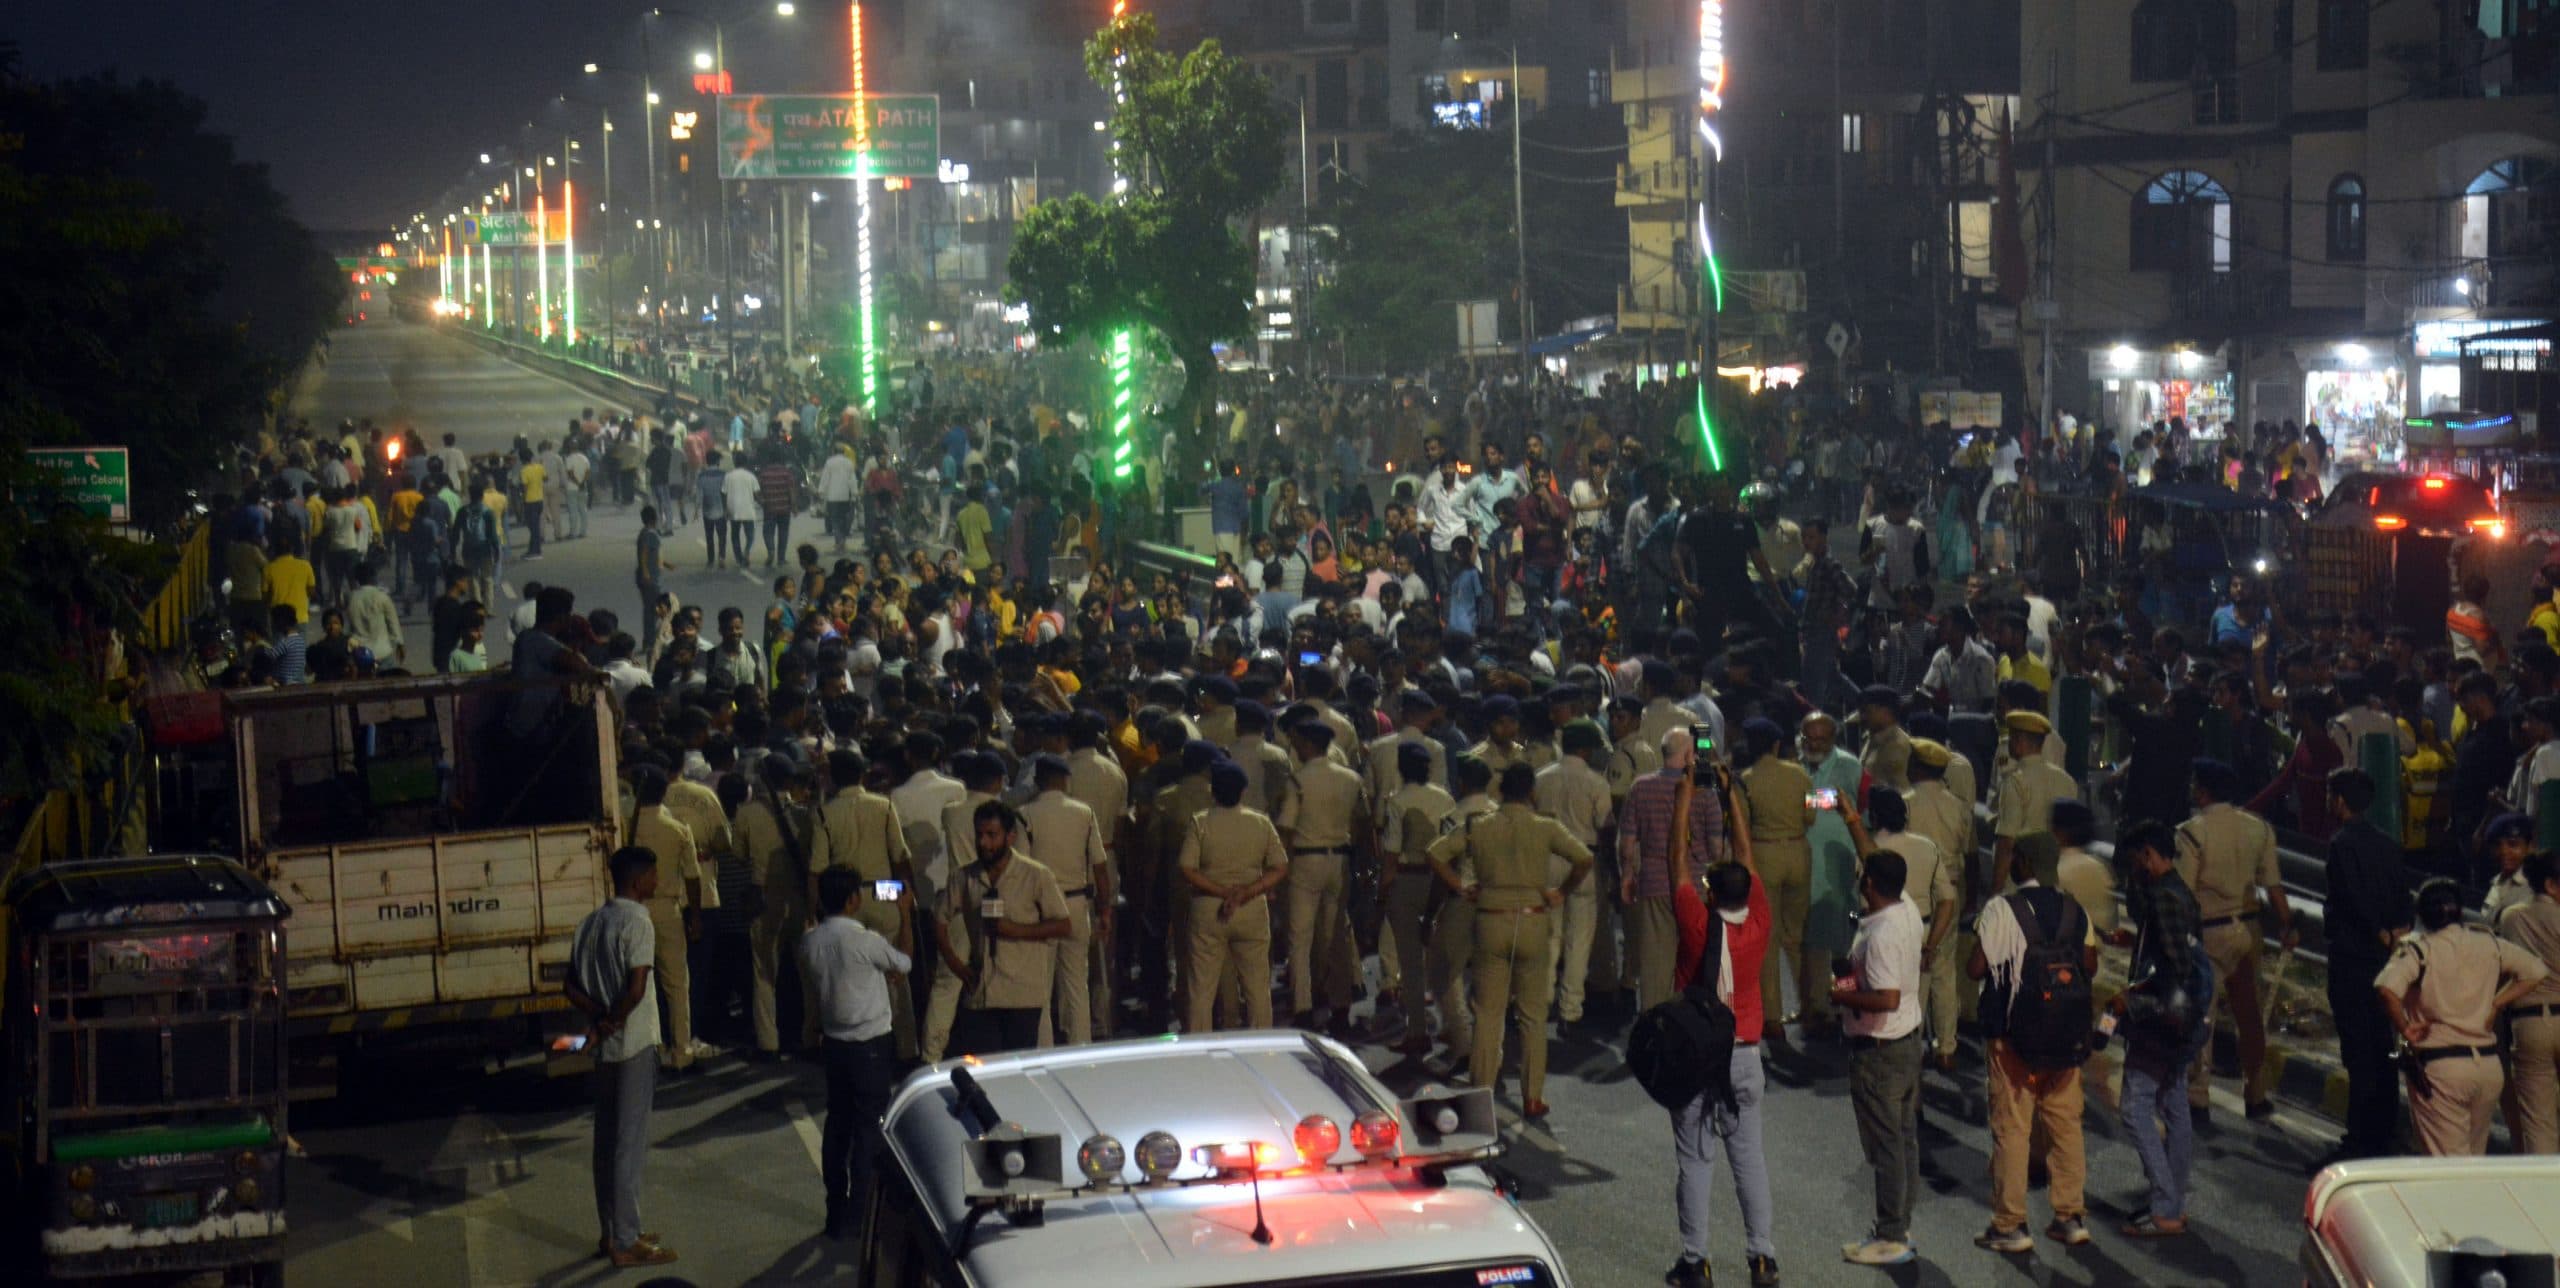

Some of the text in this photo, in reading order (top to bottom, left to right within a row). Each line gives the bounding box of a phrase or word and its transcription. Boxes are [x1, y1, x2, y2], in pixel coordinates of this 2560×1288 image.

[876, 107, 932, 128] PATH
[90, 473, 124, 487] Colony
[378, 896, 501, 921] Mahndra
[1475, 1267, 1534, 1286] POLICE
